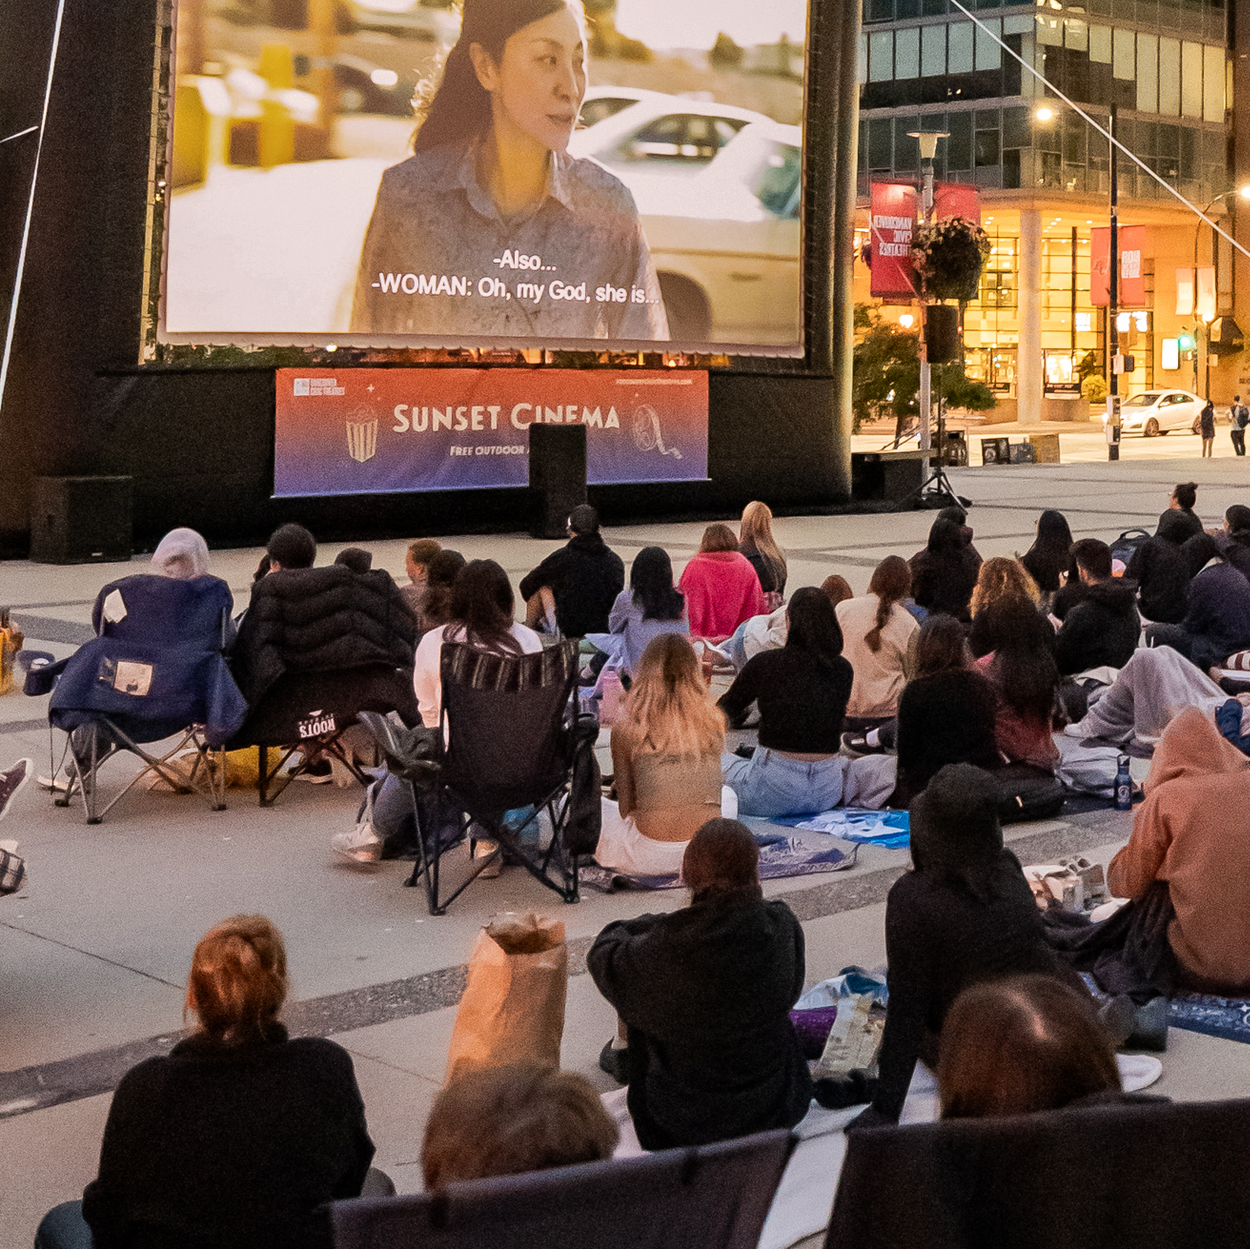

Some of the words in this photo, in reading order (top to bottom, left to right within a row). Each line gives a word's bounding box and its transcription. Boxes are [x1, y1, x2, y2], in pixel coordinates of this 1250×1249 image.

[493, 249, 557, 271] -Also...
[371, 272, 472, 296] -WOMAN:
[478, 277, 511, 300] Oh,
[516, 283, 545, 304] my
[549, 280, 591, 303] God,
[595, 283, 628, 303] she
[631, 284, 660, 304] is...
[392, 403, 501, 432] SUNSET
[510, 402, 620, 430] CINEMA
[450, 445, 473, 456] FREE
[474, 444, 526, 456] OUTDOOR
[299, 717, 336, 738] ROOTS
